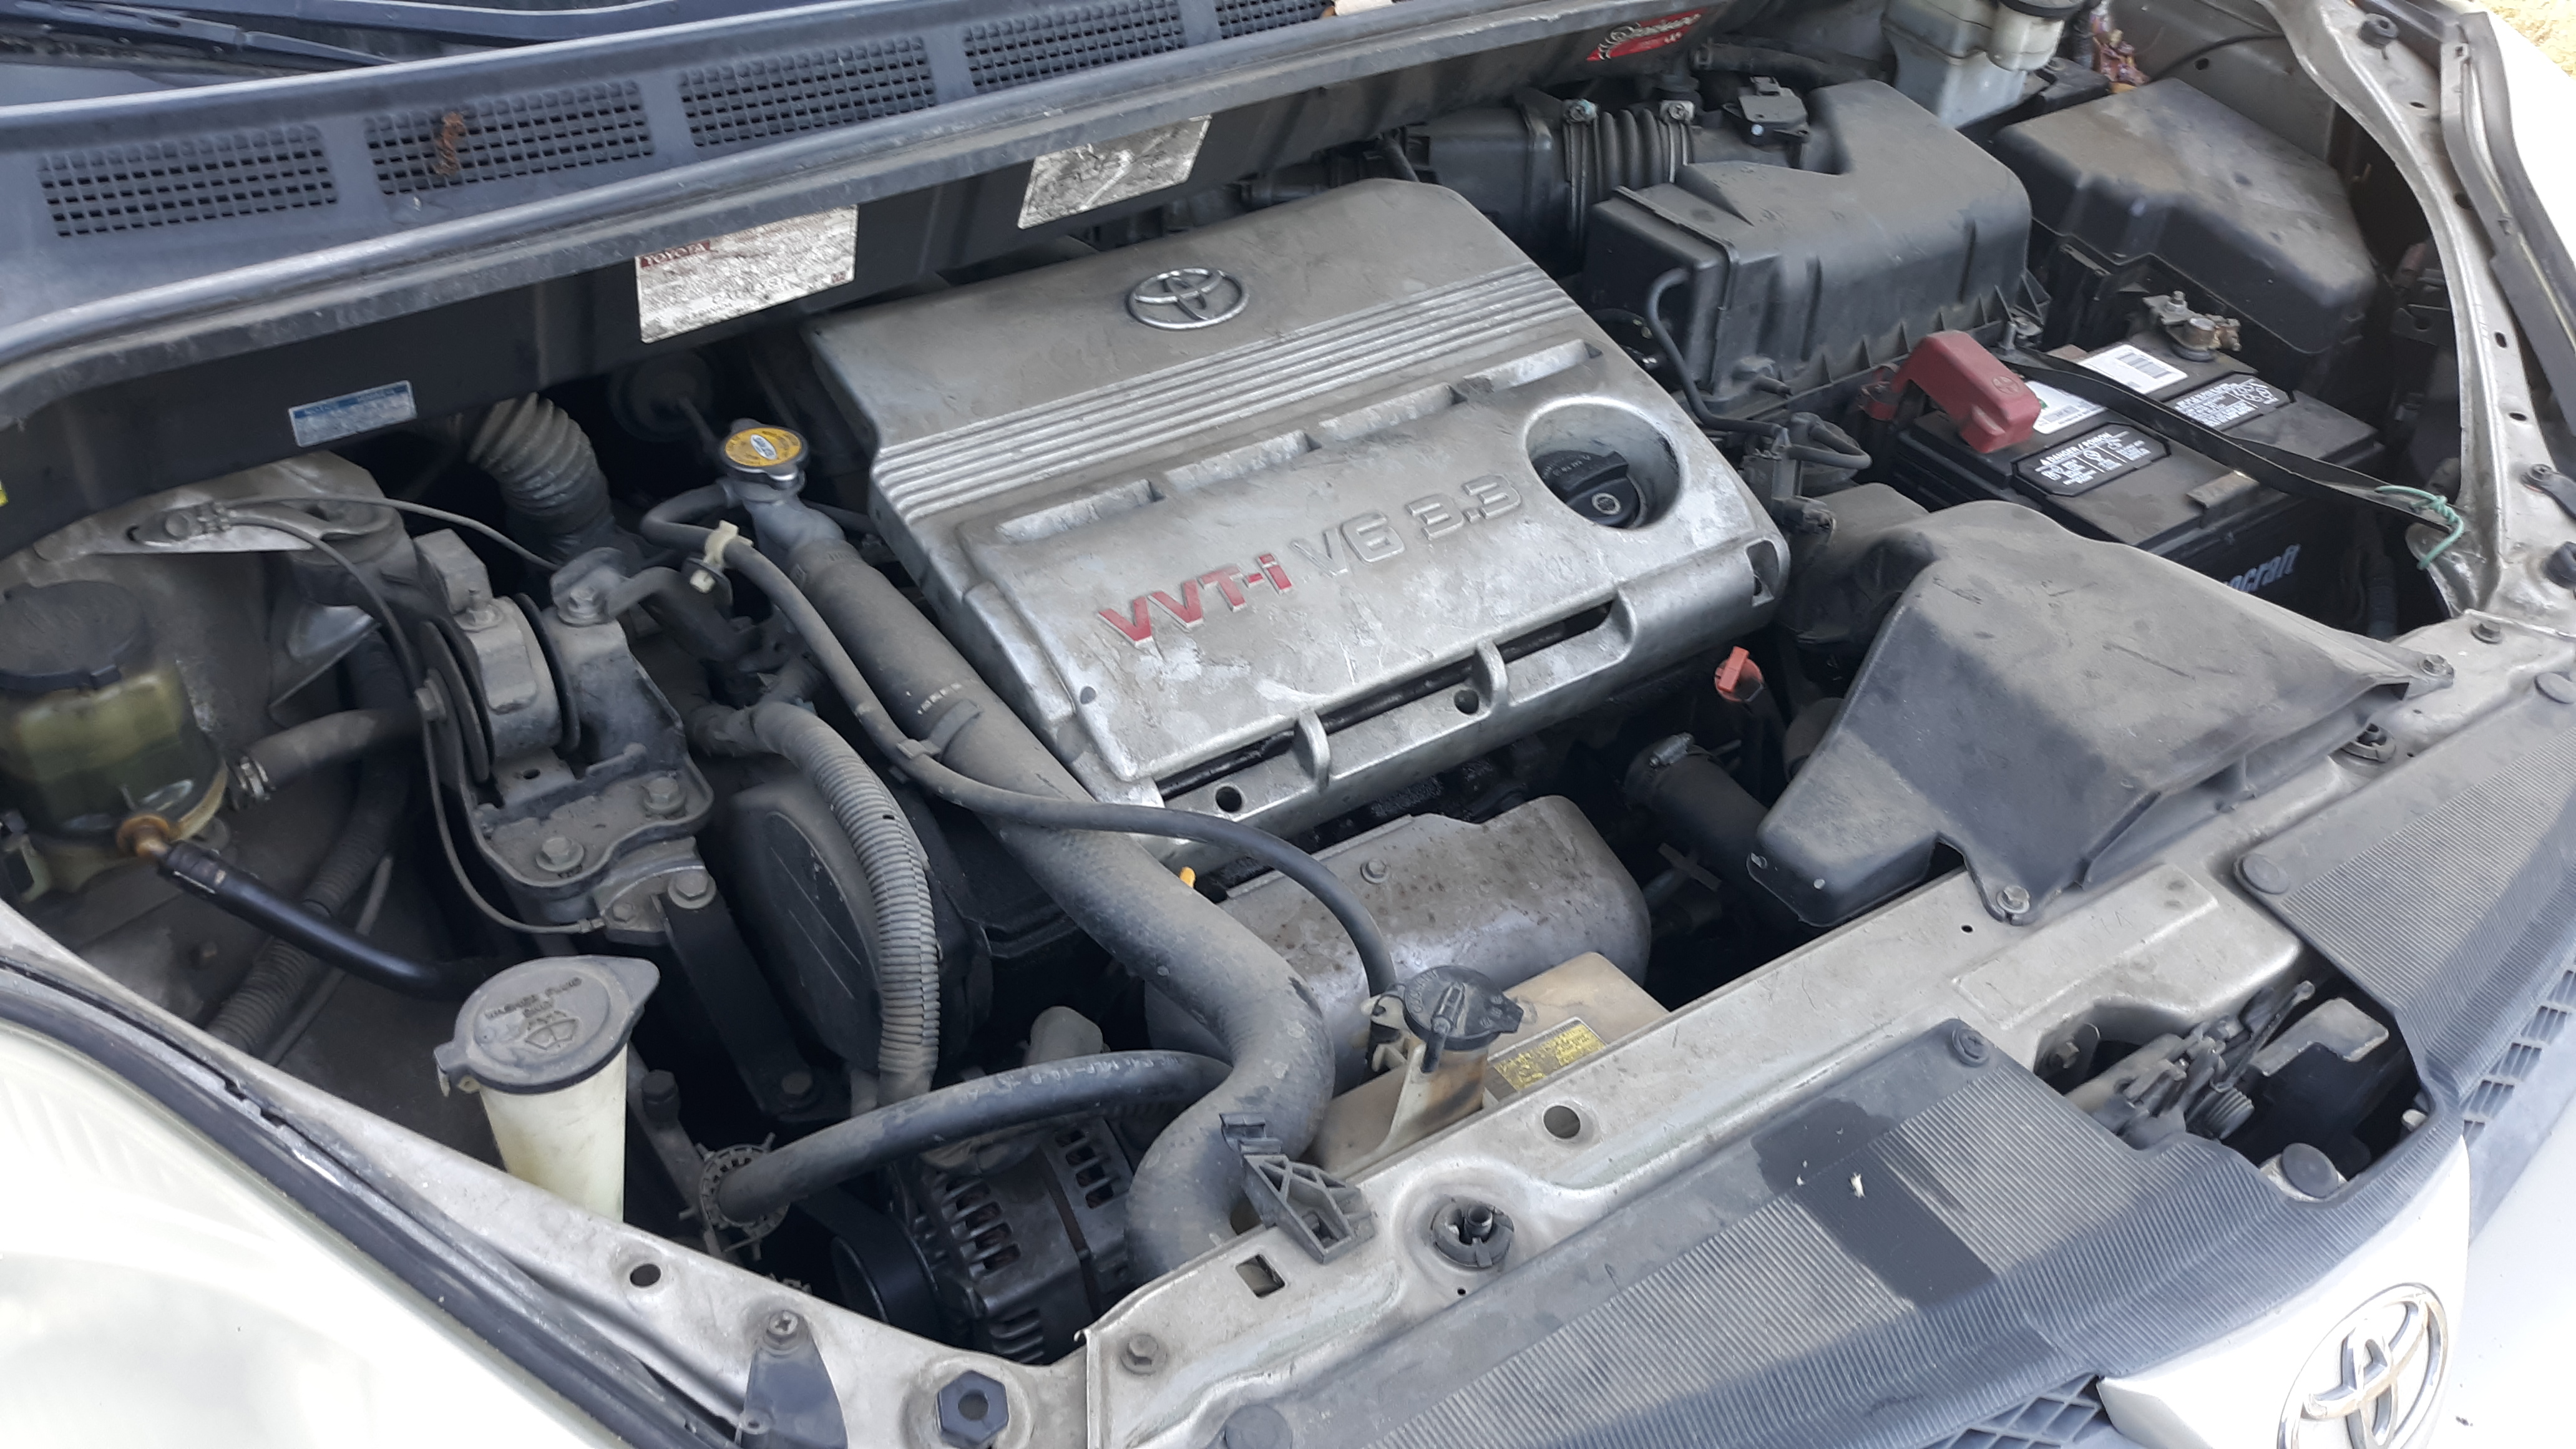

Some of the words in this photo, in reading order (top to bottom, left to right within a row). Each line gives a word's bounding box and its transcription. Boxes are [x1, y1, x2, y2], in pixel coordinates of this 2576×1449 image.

[2047, 446, 2080, 464] DANGER
[1098, 554, 1292, 648] VVT-i
[1290, 512, 1407, 577] V6
[1405, 474, 1523, 540] 3.3
